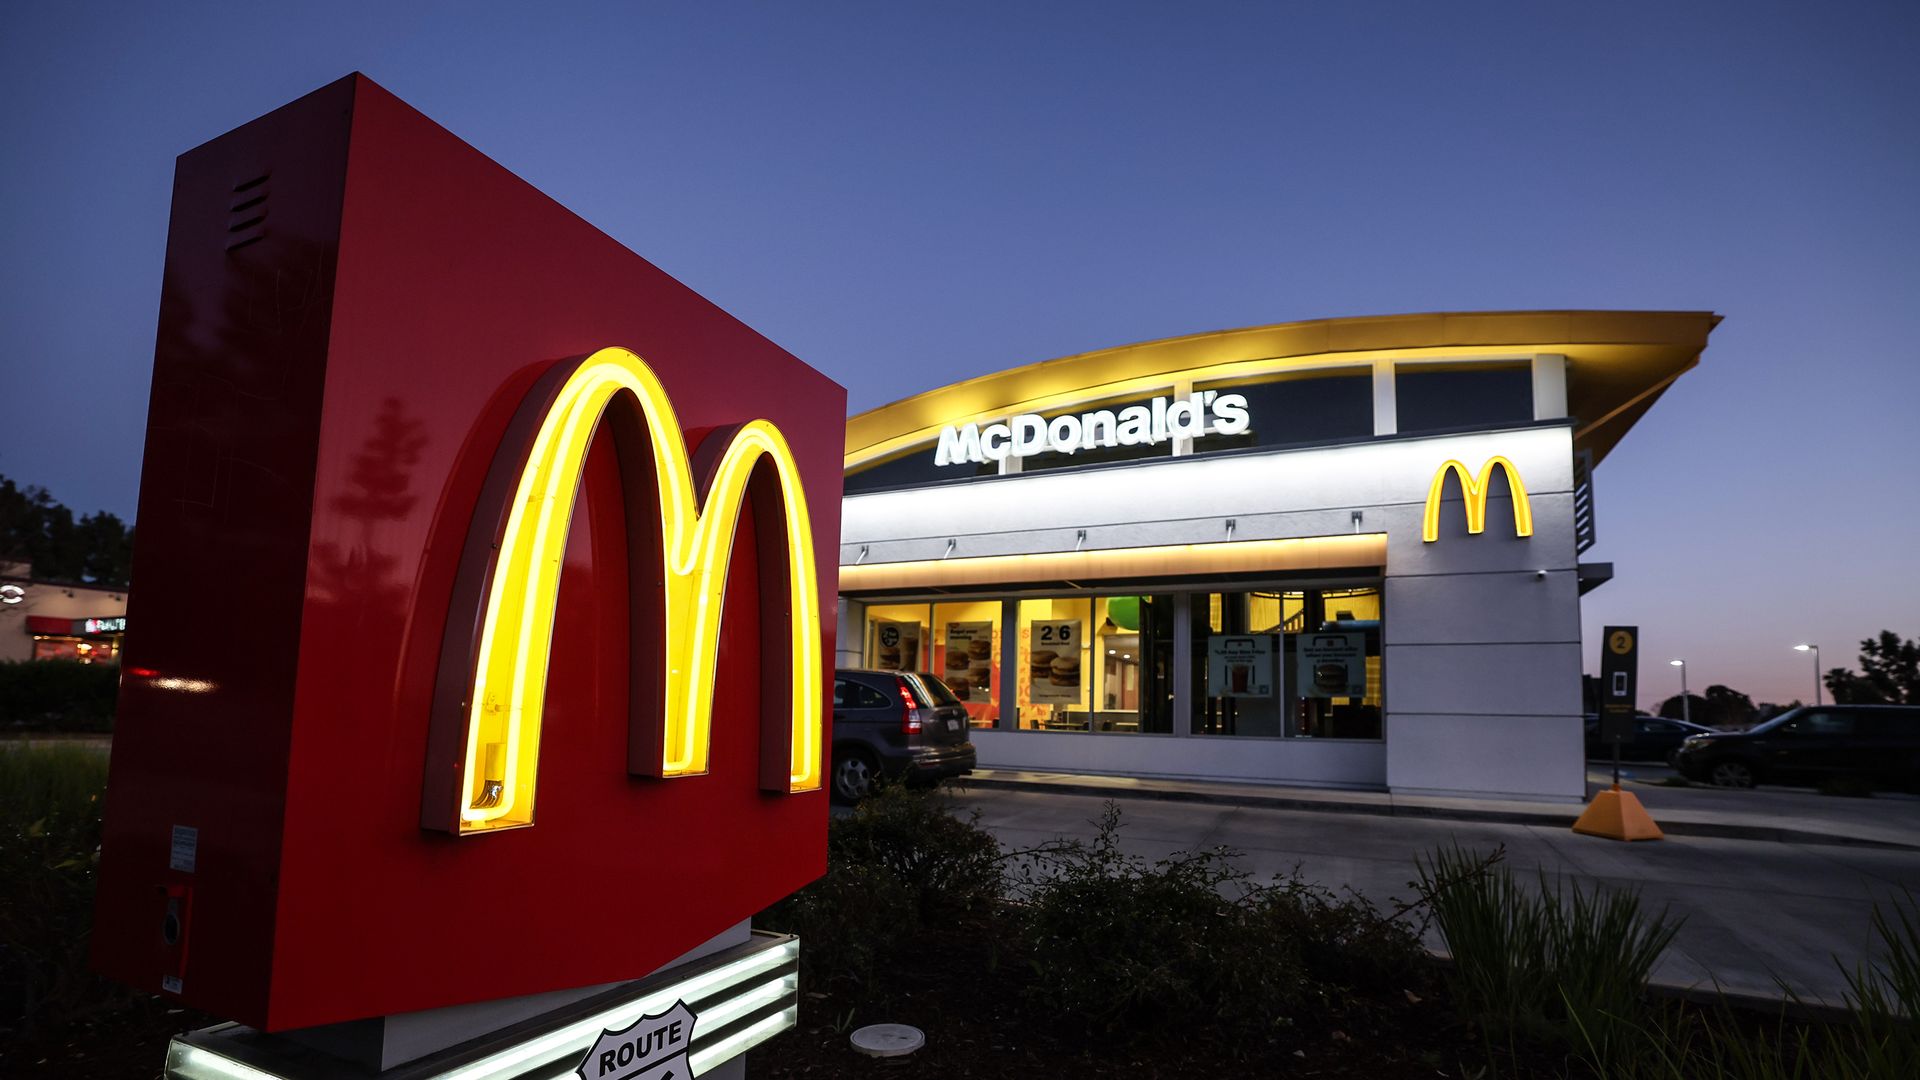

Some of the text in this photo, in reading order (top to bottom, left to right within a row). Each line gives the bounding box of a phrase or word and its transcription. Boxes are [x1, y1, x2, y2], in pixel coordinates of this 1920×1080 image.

[933, 390, 1251, 467] McDonald's
[1041, 625, 1053, 641] 2
[1616, 636, 1626, 648] 2
[598, 1019, 683, 1078] ROUTE
